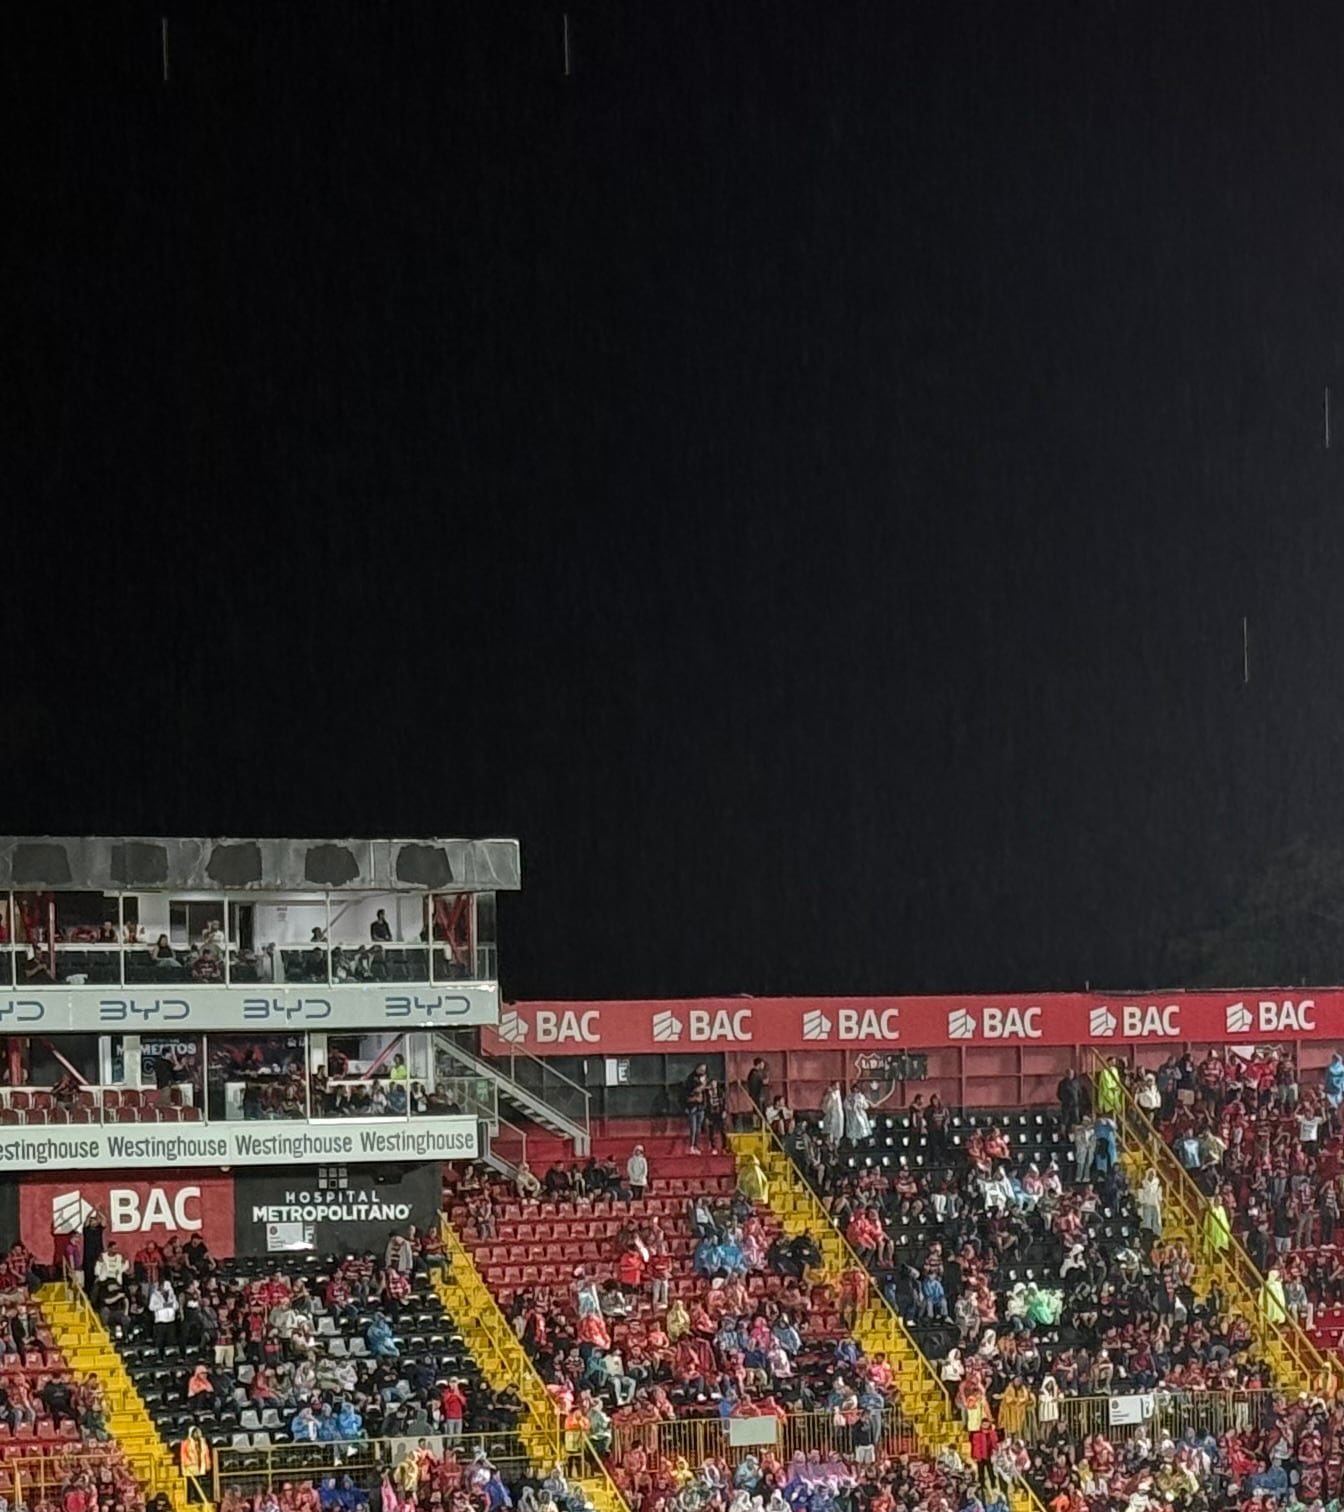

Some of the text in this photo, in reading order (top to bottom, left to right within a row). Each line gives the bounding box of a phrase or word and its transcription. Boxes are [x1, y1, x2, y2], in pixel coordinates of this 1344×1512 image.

[100, 999, 190, 1021] BYD
[243, 998, 332, 1020] BYD
[385, 995, 470, 1017] BYD
[536, 1010, 600, 1043] BAC
[689, 1009, 752, 1041] BAC
[838, 1008, 900, 1040] BAC
[983, 1007, 1042, 1039] BAC
[1123, 1005, 1181, 1036] BAC
[1259, 1000, 1316, 1032] BAC
[117, 1043, 196, 1056] MMETOS
[107, 1136, 227, 1161] Westinghouse
[234, 1133, 353, 1158] Westinghouse
[360, 1130, 474, 1155] Westinghouse
[110, 1186, 202, 1233] BAC
[285, 1190, 380, 1203] HOSPITAL
[252, 1204, 411, 1223] METROPOLITANO
